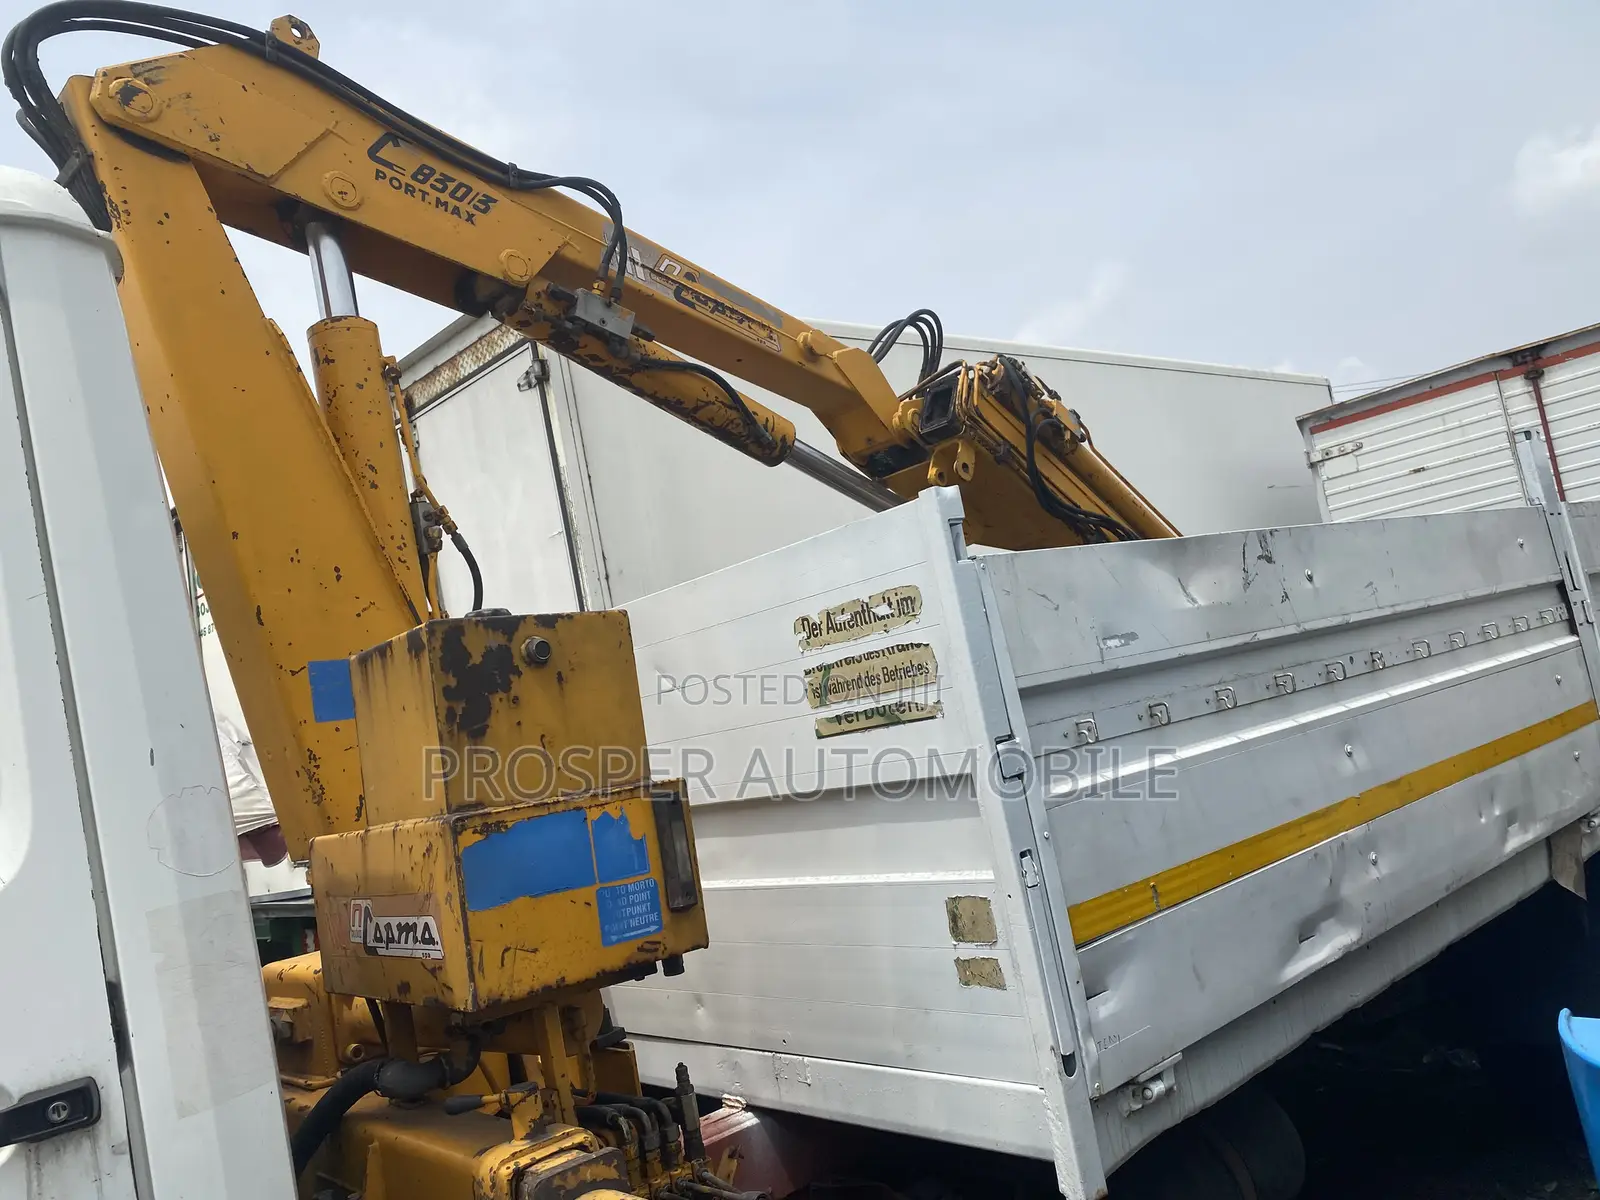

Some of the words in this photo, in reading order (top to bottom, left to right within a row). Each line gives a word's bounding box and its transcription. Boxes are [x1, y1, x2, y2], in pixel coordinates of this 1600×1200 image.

[374, 168, 476, 227] PORT.MAX
[801, 616, 823, 641] Der
[864, 670, 882, 688] des
[882, 659, 931, 685] Betriebes
[627, 878, 655, 893] MORTO
[629, 890, 651, 905] POINT
[629, 912, 659, 928] NEUTRE
